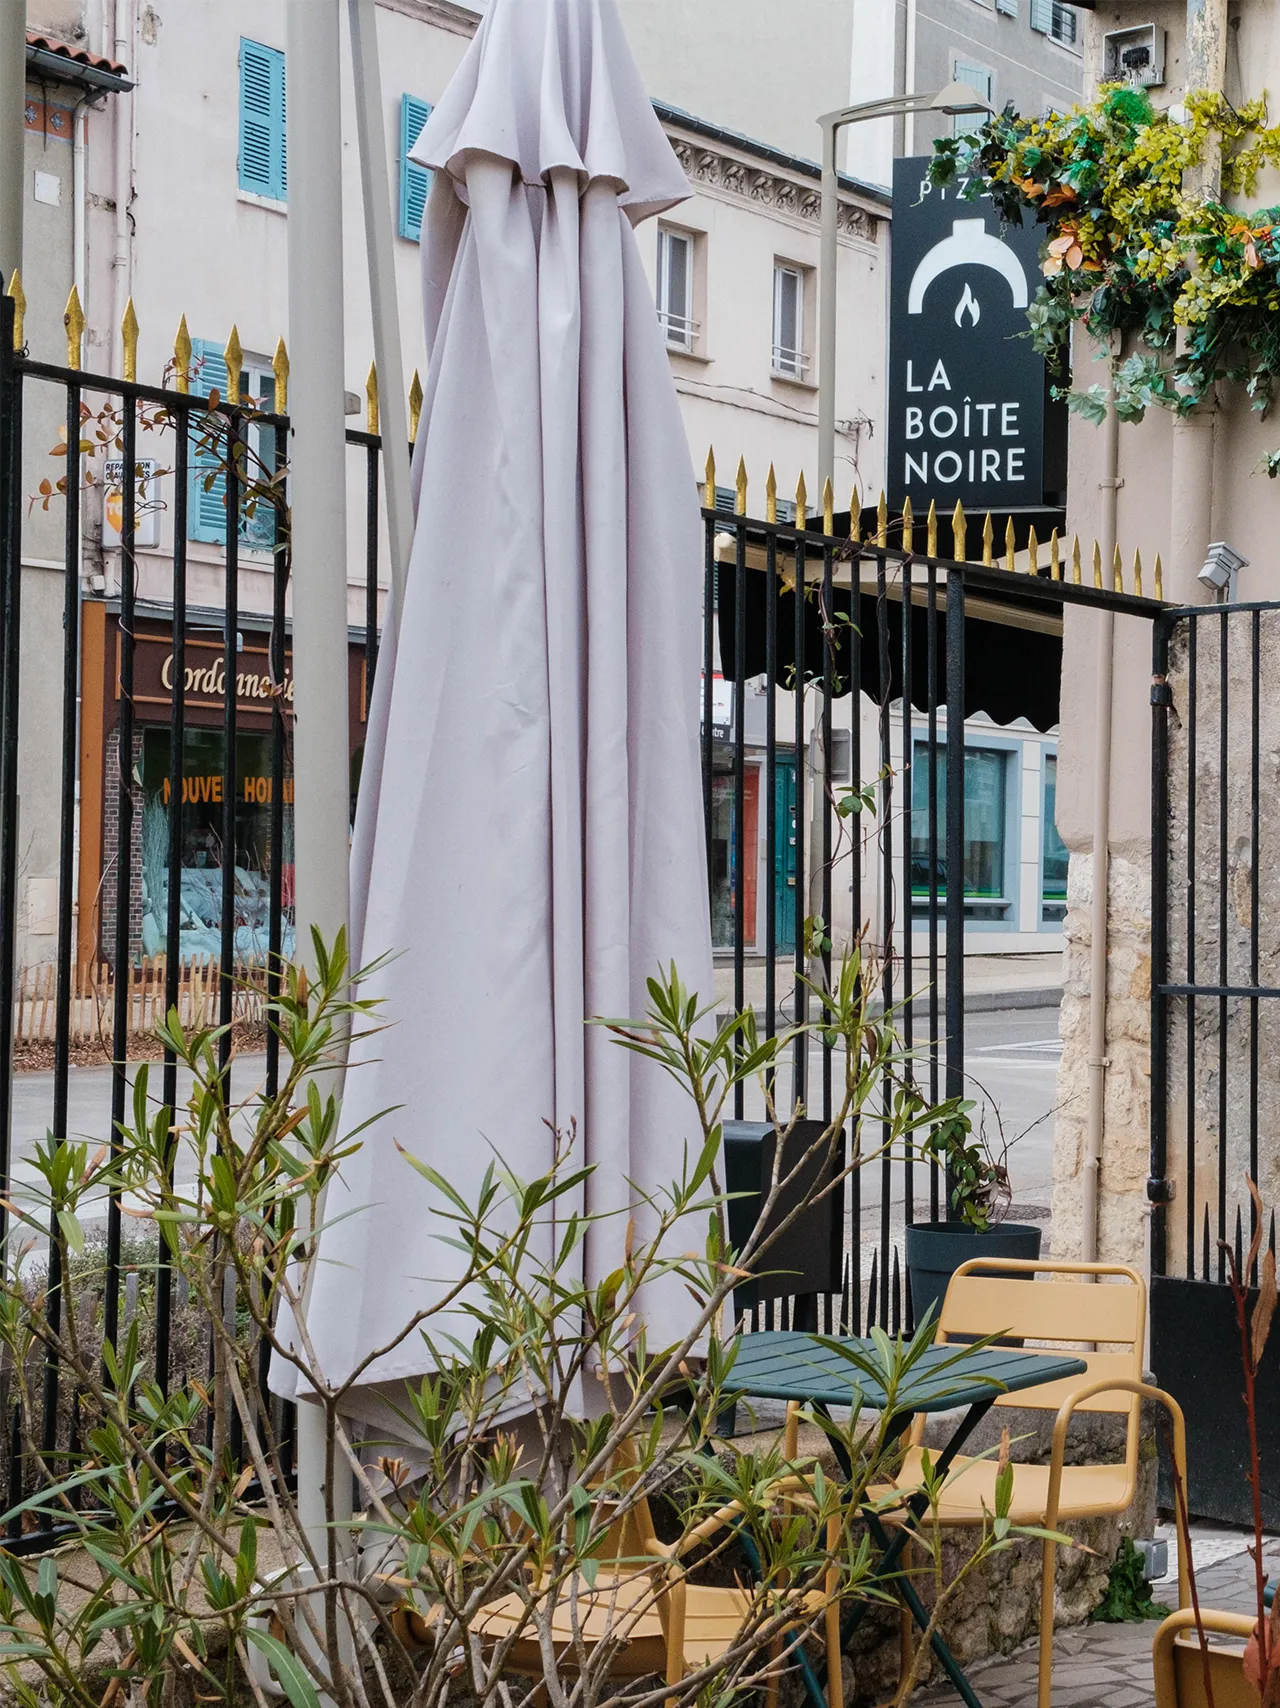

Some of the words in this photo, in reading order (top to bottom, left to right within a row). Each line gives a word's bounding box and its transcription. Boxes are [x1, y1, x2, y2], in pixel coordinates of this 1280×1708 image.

[906, 358, 952, 392] LA
[905, 395, 1020, 440] BOÎTE
[904, 448, 1025, 485] NOIRE
[161, 653, 294, 701] Cordonneie
